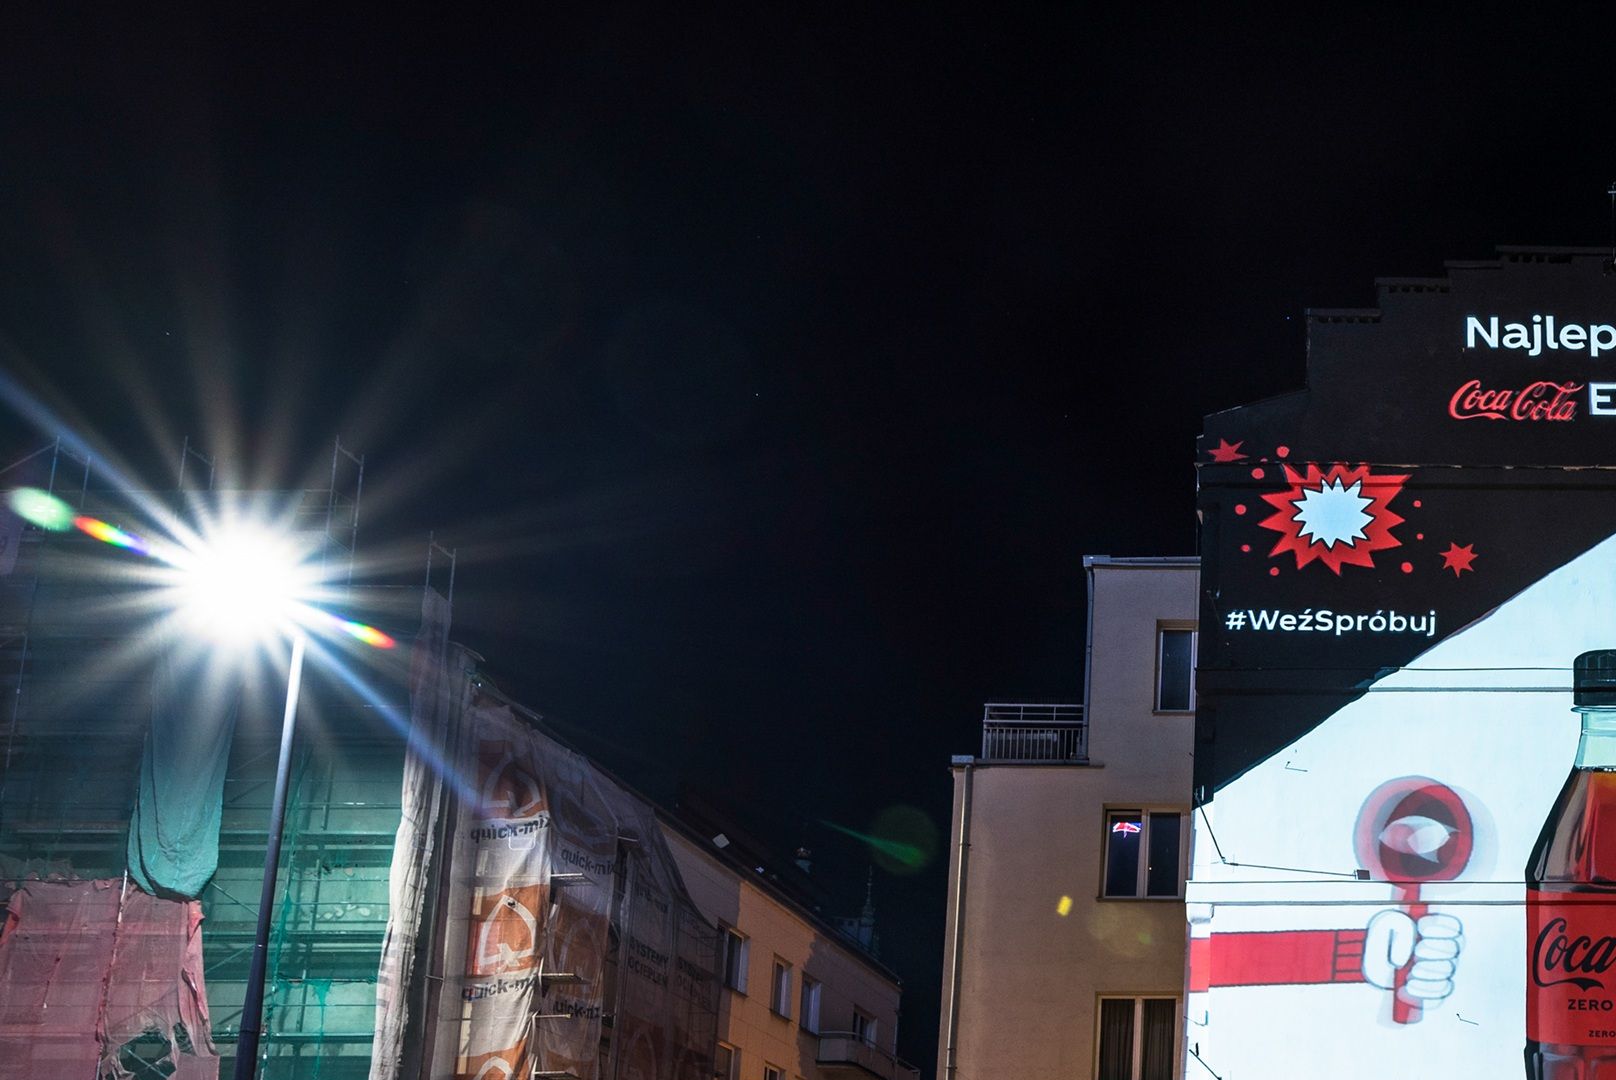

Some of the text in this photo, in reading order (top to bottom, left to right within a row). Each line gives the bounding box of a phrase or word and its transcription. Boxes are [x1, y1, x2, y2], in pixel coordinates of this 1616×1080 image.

[1225, 609, 1436, 636] #WeźSpróbuj
[1568, 998, 1613, 1011] ZERO
[1589, 1029, 1616, 1038] ZERO
